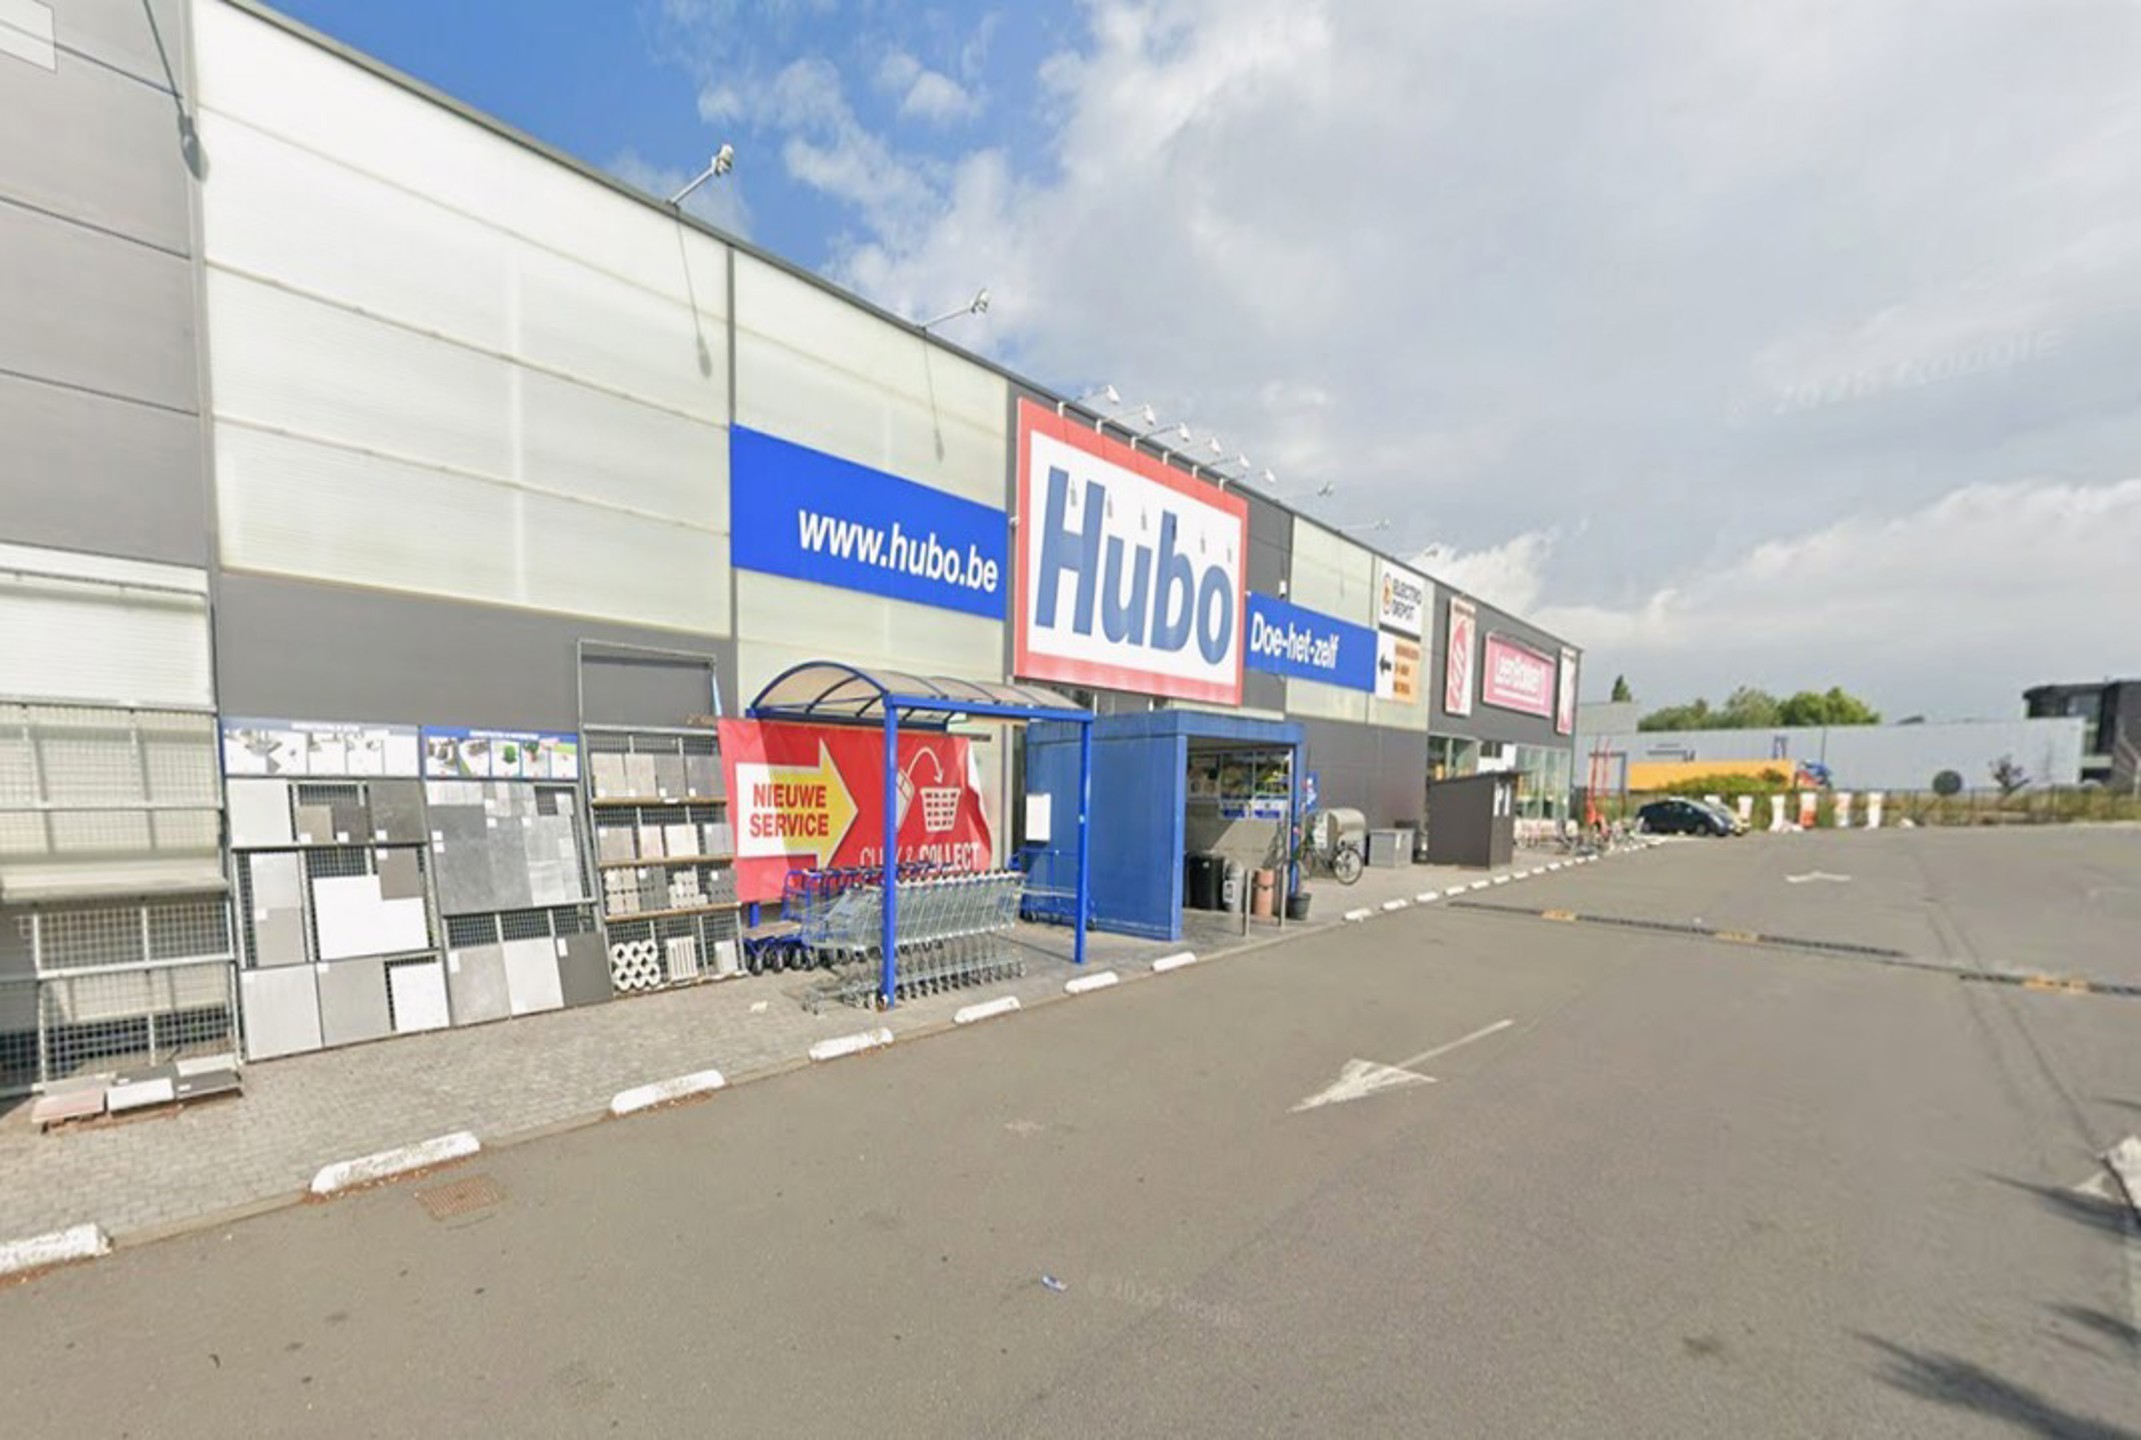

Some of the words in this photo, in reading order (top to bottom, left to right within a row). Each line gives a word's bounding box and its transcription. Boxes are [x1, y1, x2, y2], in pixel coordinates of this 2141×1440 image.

[799, 508, 998, 593] www.hubo.be
[1034, 464, 1234, 666] Hubo
[753, 783, 827, 809] NIEUWE
[749, 813, 829, 838] SERVICE
